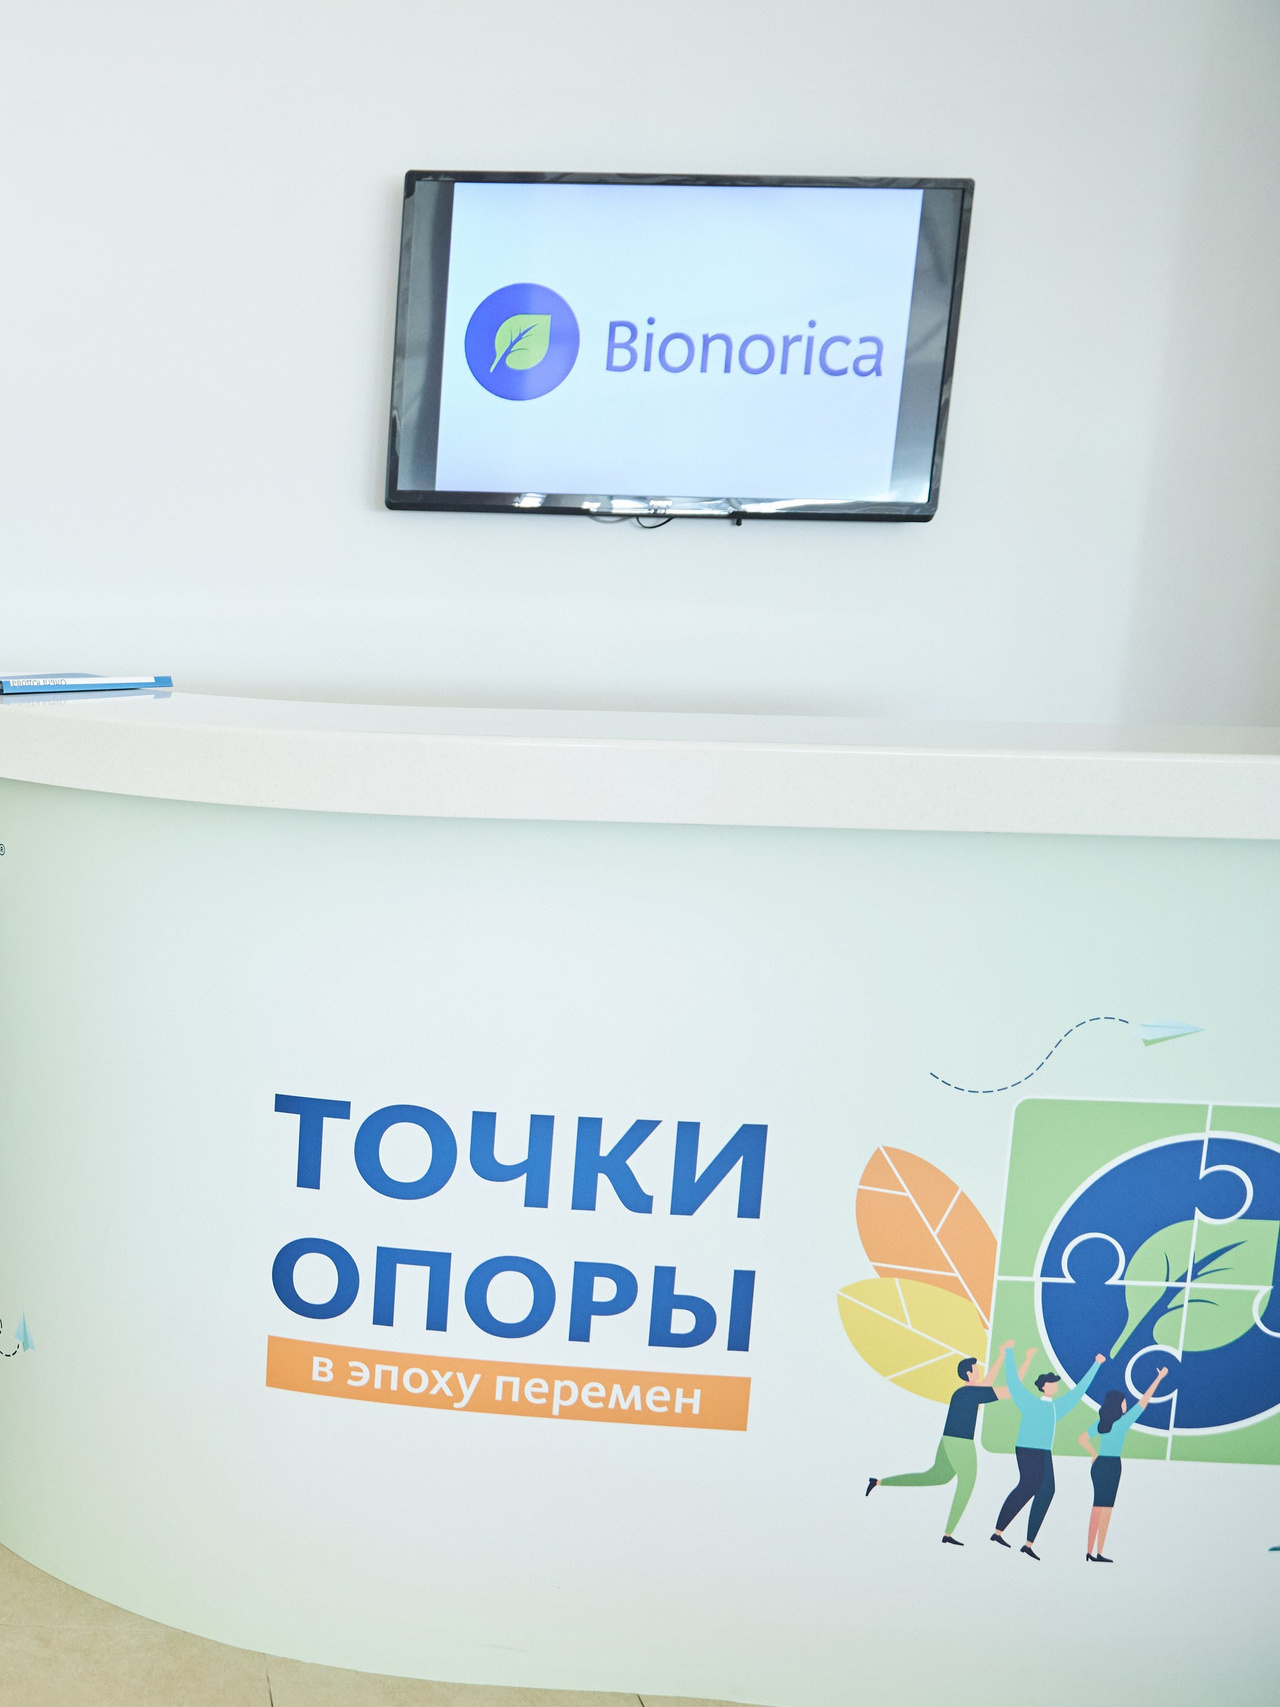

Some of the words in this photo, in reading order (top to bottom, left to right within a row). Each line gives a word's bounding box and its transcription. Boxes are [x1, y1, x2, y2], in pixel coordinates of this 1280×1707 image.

[604, 316, 884, 378] Bionorica
[274, 1093, 769, 1220] ТОЧКИ
[271, 1237, 756, 1353] ОПОРЫ
[312, 1356, 335, 1384] в
[346, 1359, 482, 1409] эпоху
[494, 1373, 703, 1416] перемен
